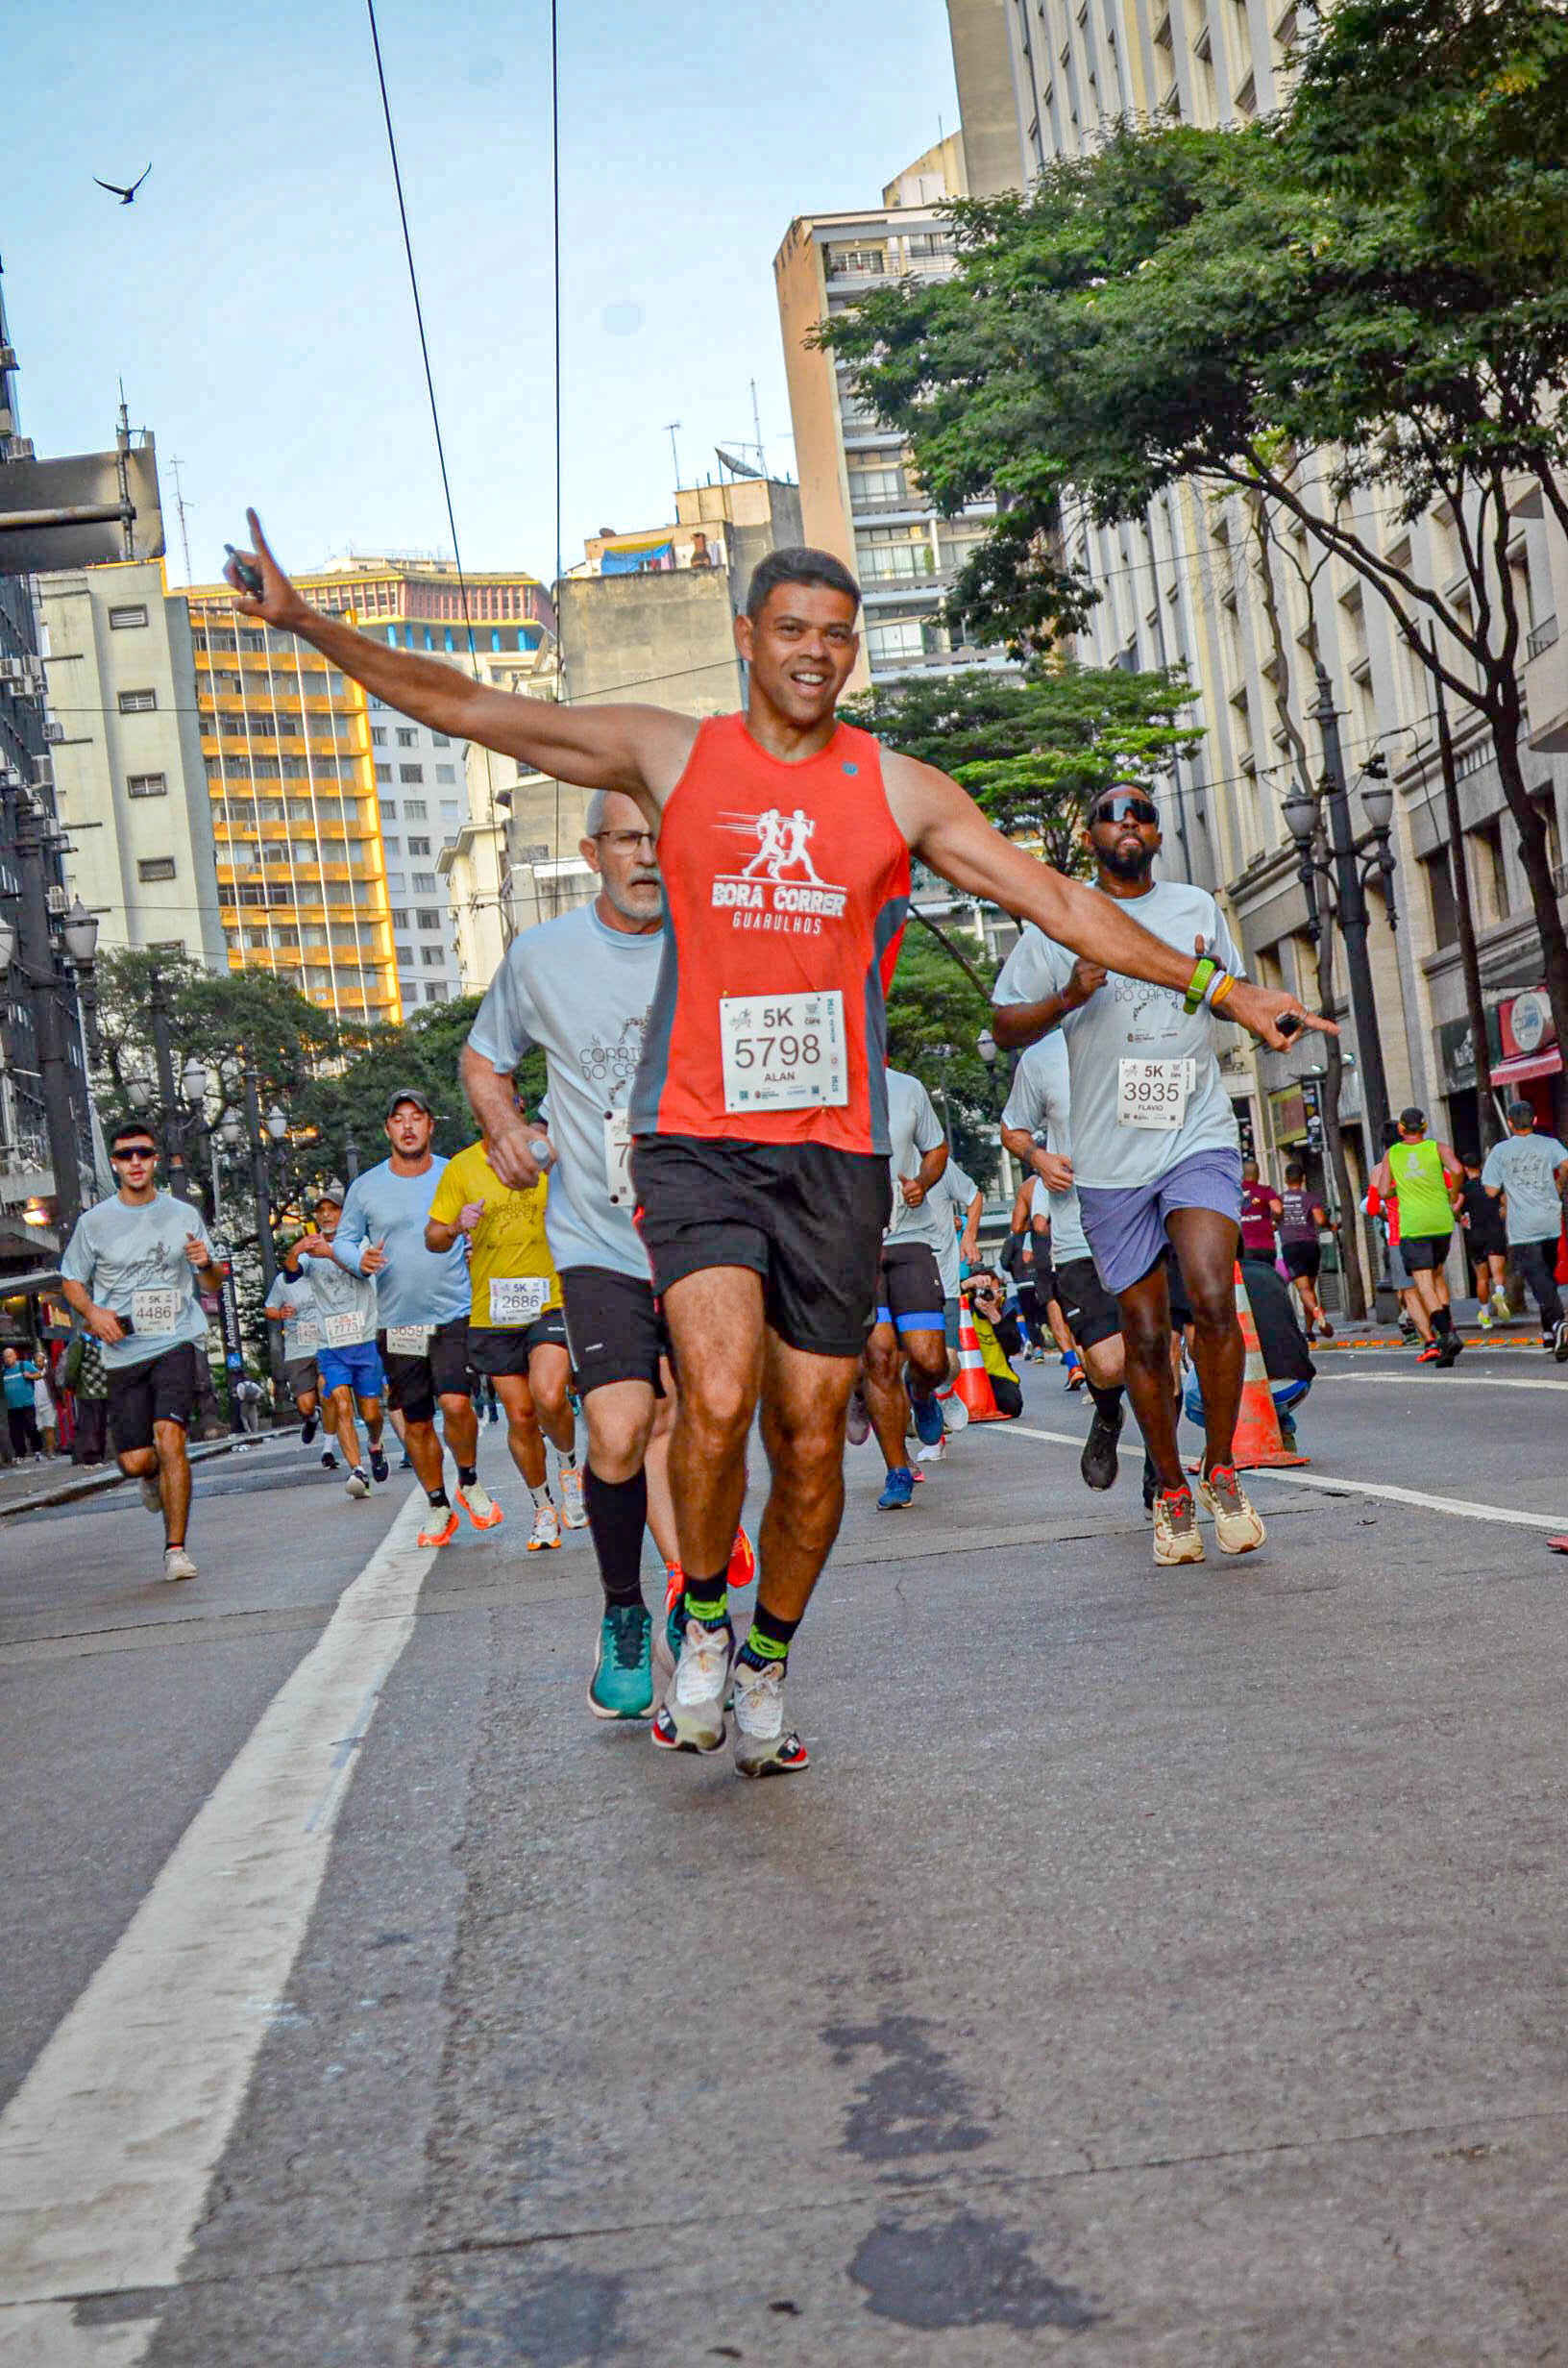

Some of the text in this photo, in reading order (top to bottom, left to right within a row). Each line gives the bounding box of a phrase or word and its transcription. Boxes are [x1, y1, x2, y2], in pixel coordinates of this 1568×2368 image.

[711, 881, 846, 918] BORA CORRER
[732, 910, 822, 935] GUARULHOS
[1115, 989, 1135, 1002] DO
[763, 1006, 794, 1028] 5K
[734, 1033, 821, 1069] 5798
[581, 1063, 607, 1081] DO
[764, 1071, 796, 1082] ALAN
[1144, 1065, 1164, 1077] 5K
[1123, 1082, 1179, 1102] 3935
[513, 1283, 527, 1293] 5K
[148, 1295, 161, 1304] 5K
[502, 1295, 539, 1309] 2686
[135, 1305, 171, 1320] 4486
